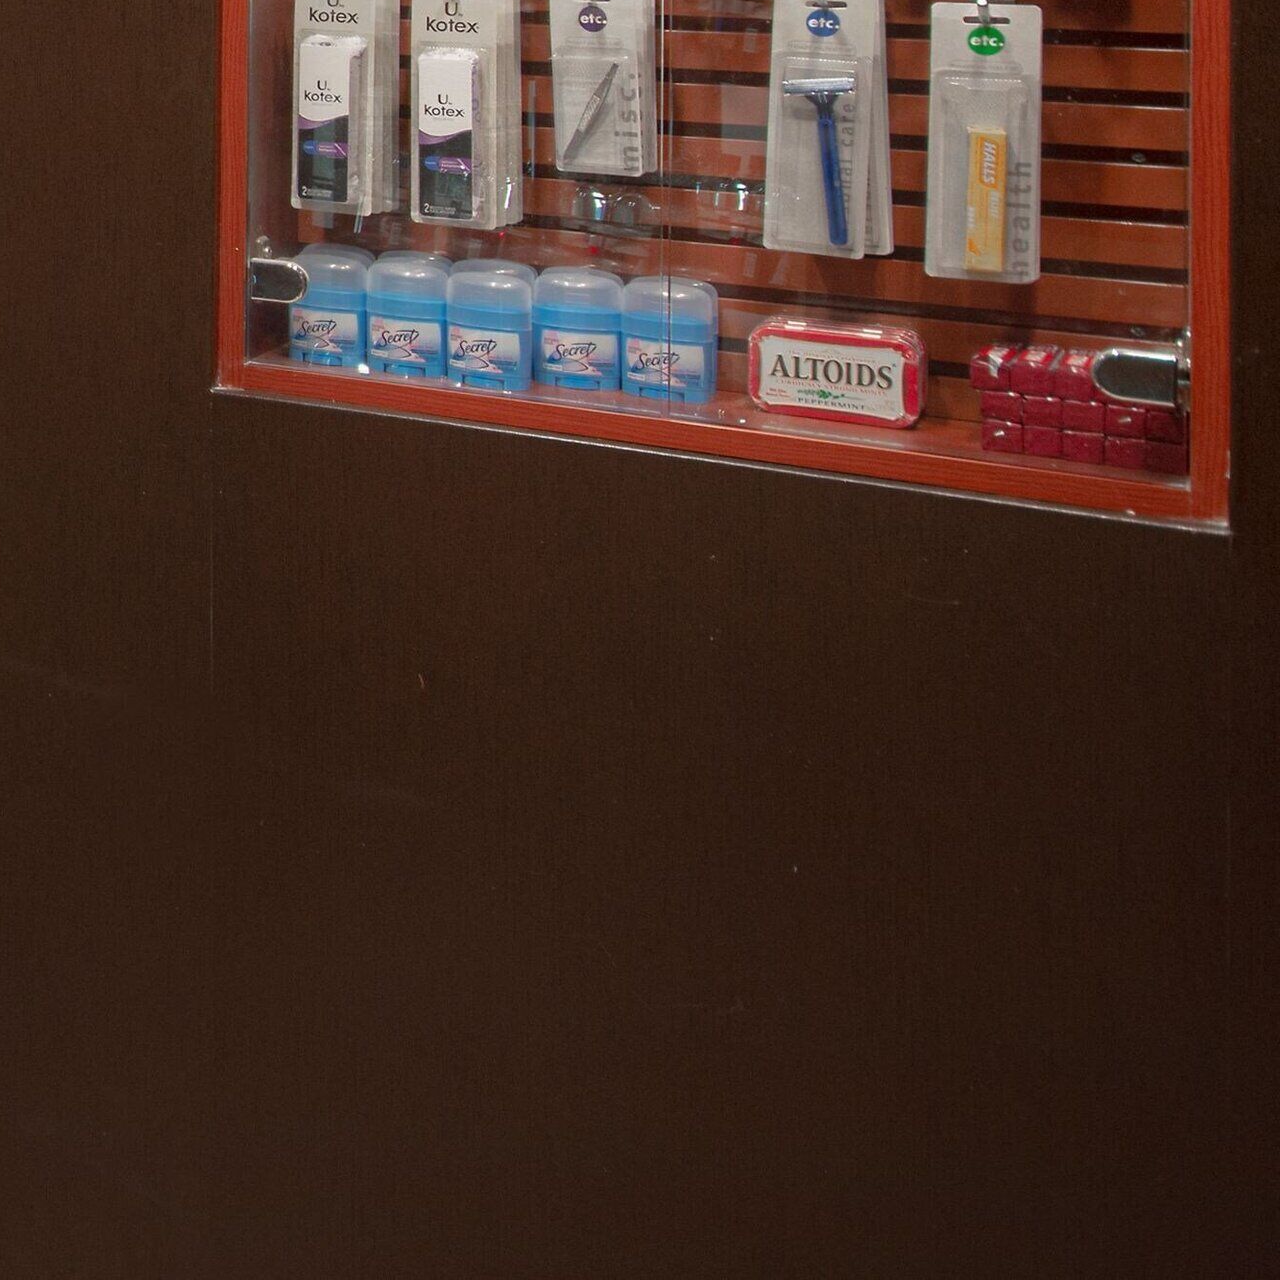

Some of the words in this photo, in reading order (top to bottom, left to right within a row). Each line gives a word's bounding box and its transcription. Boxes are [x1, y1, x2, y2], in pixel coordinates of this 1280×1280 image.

[444, 0, 459, 17] U
[579, 13, 608, 25] etc.
[808, 17, 840, 30] etc.
[969, 33, 1004, 48] etc.
[316, 79, 329, 92] U
[437, 93, 450, 106] U
[613, 73, 640, 171] misc.
[982, 140, 999, 185] HALLS
[301, 185, 308, 196] 2
[423, 202, 431, 212] 2
[1006, 160, 1034, 277] health
[296, 319, 338, 338] Secret
[379, 328, 421, 348] Secret
[456, 338, 499, 358] Secret
[552, 341, 598, 361] Secret
[636, 351, 682, 372] Secret
[770, 353, 894, 390] ALTOIDS
[797, 397, 865, 411] PEPPERMINT
